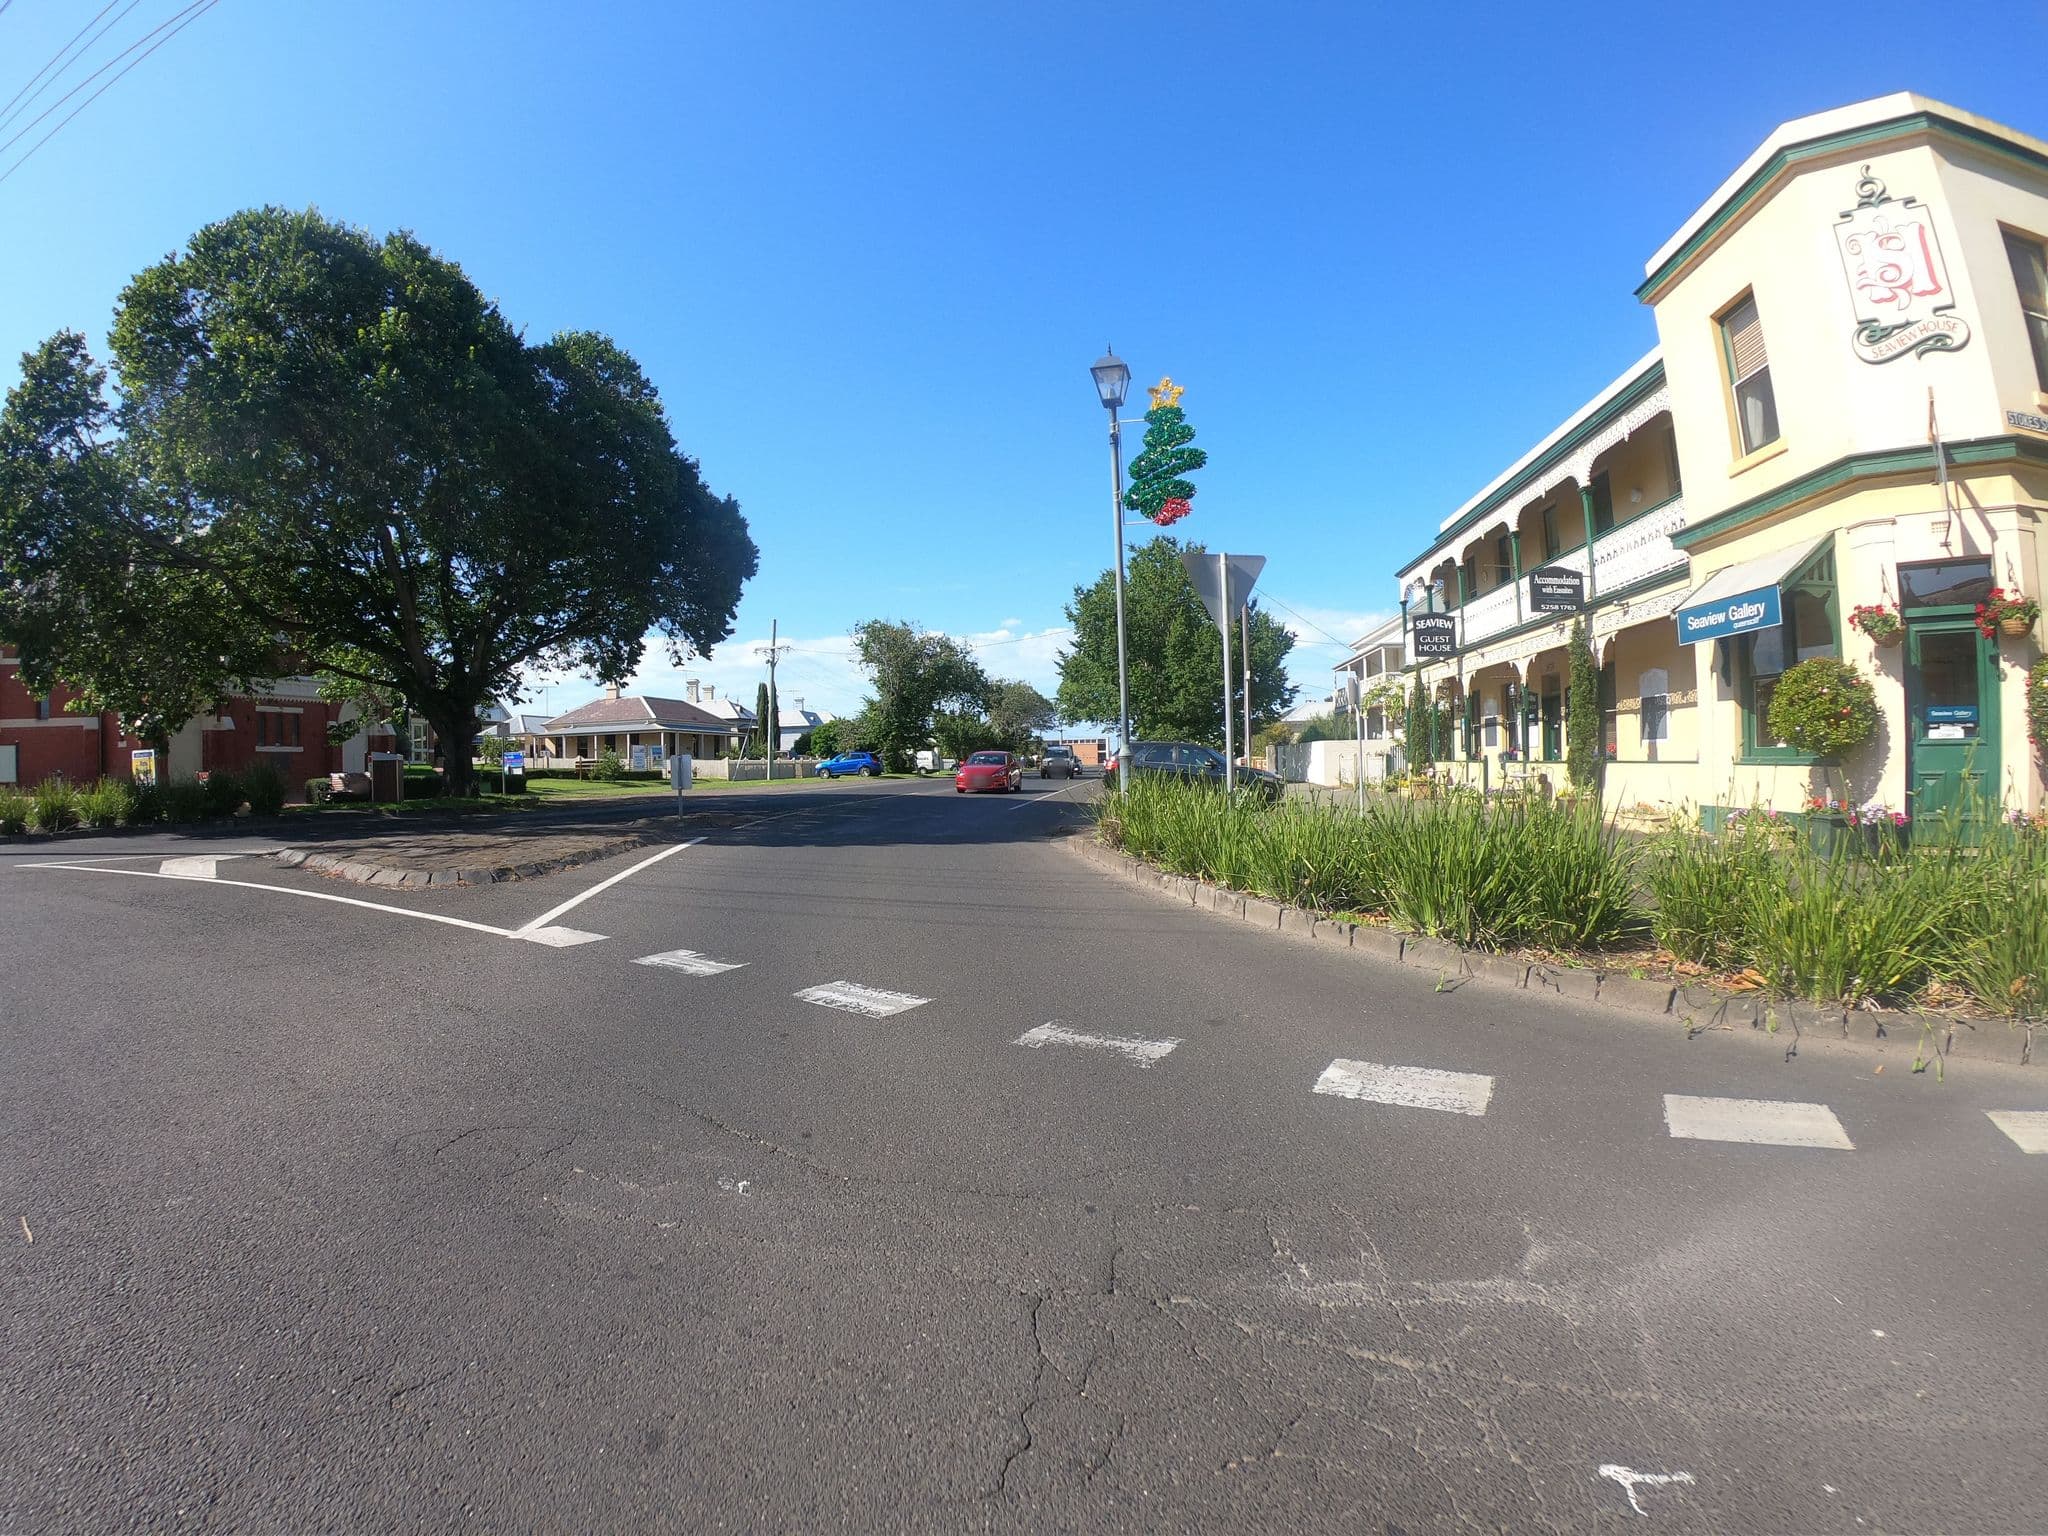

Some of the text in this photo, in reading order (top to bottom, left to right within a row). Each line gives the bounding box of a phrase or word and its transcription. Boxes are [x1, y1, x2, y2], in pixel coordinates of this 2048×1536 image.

[1872, 320, 1959, 359] SEAVIEW HOUSE
[2007, 412, 2041, 429] STOKES
[1533, 574, 1580, 585] Accommodation
[1687, 602, 1765, 630] Seaview Gallery
[1415, 618, 1454, 630] SEAVIEW
[1419, 635, 1451, 643] GUEST
[1418, 644, 1452, 652] HOUSE
